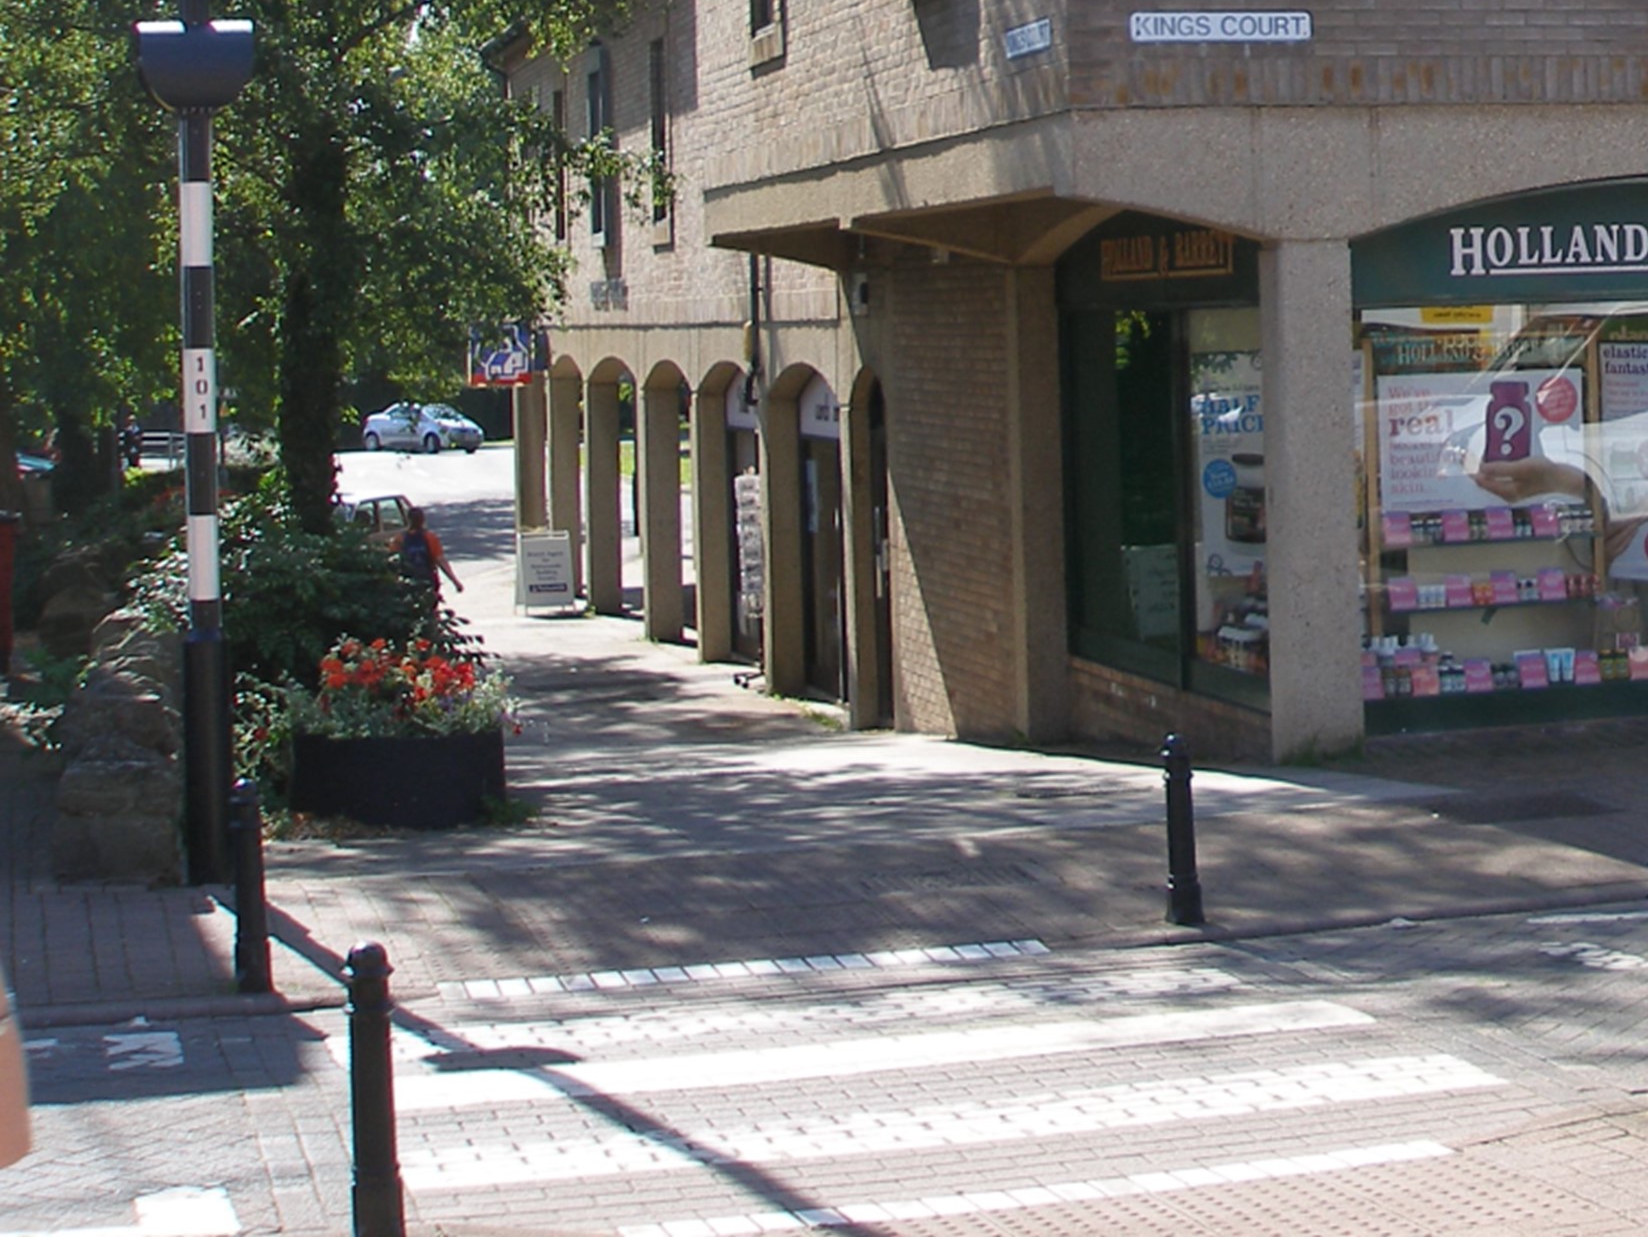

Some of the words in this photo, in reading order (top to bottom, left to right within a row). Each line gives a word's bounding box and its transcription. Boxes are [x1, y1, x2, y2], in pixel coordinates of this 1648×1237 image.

[1135, 16, 1211, 37] KINGS
[1220, 16, 1306, 36] COURT
[1603, 345, 1648, 360] elastic
[1389, 410, 1454, 437] real
